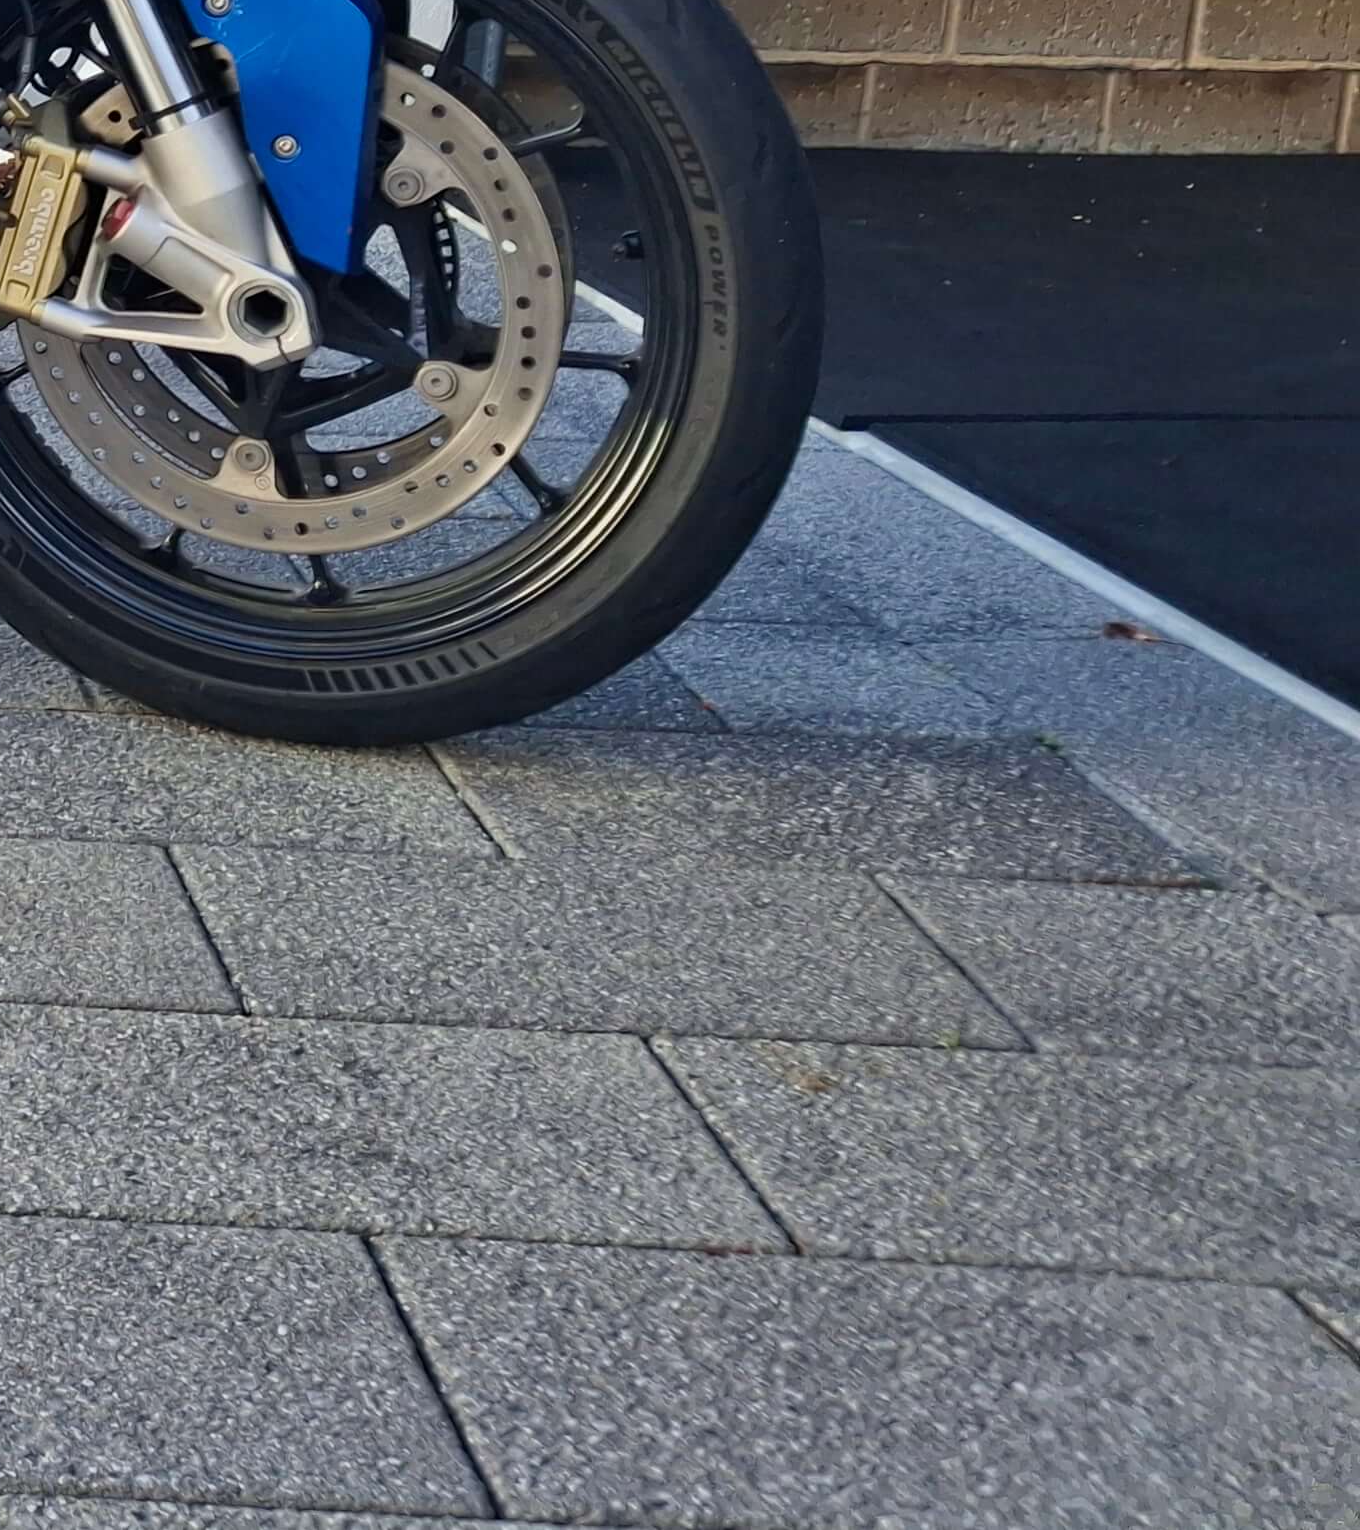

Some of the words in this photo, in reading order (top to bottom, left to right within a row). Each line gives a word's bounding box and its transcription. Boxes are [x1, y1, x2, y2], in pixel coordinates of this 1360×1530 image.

[605, 37, 714, 199] MICHELIN
[14, 187, 56, 276] brembo
[703, 224, 729, 338] POWER
